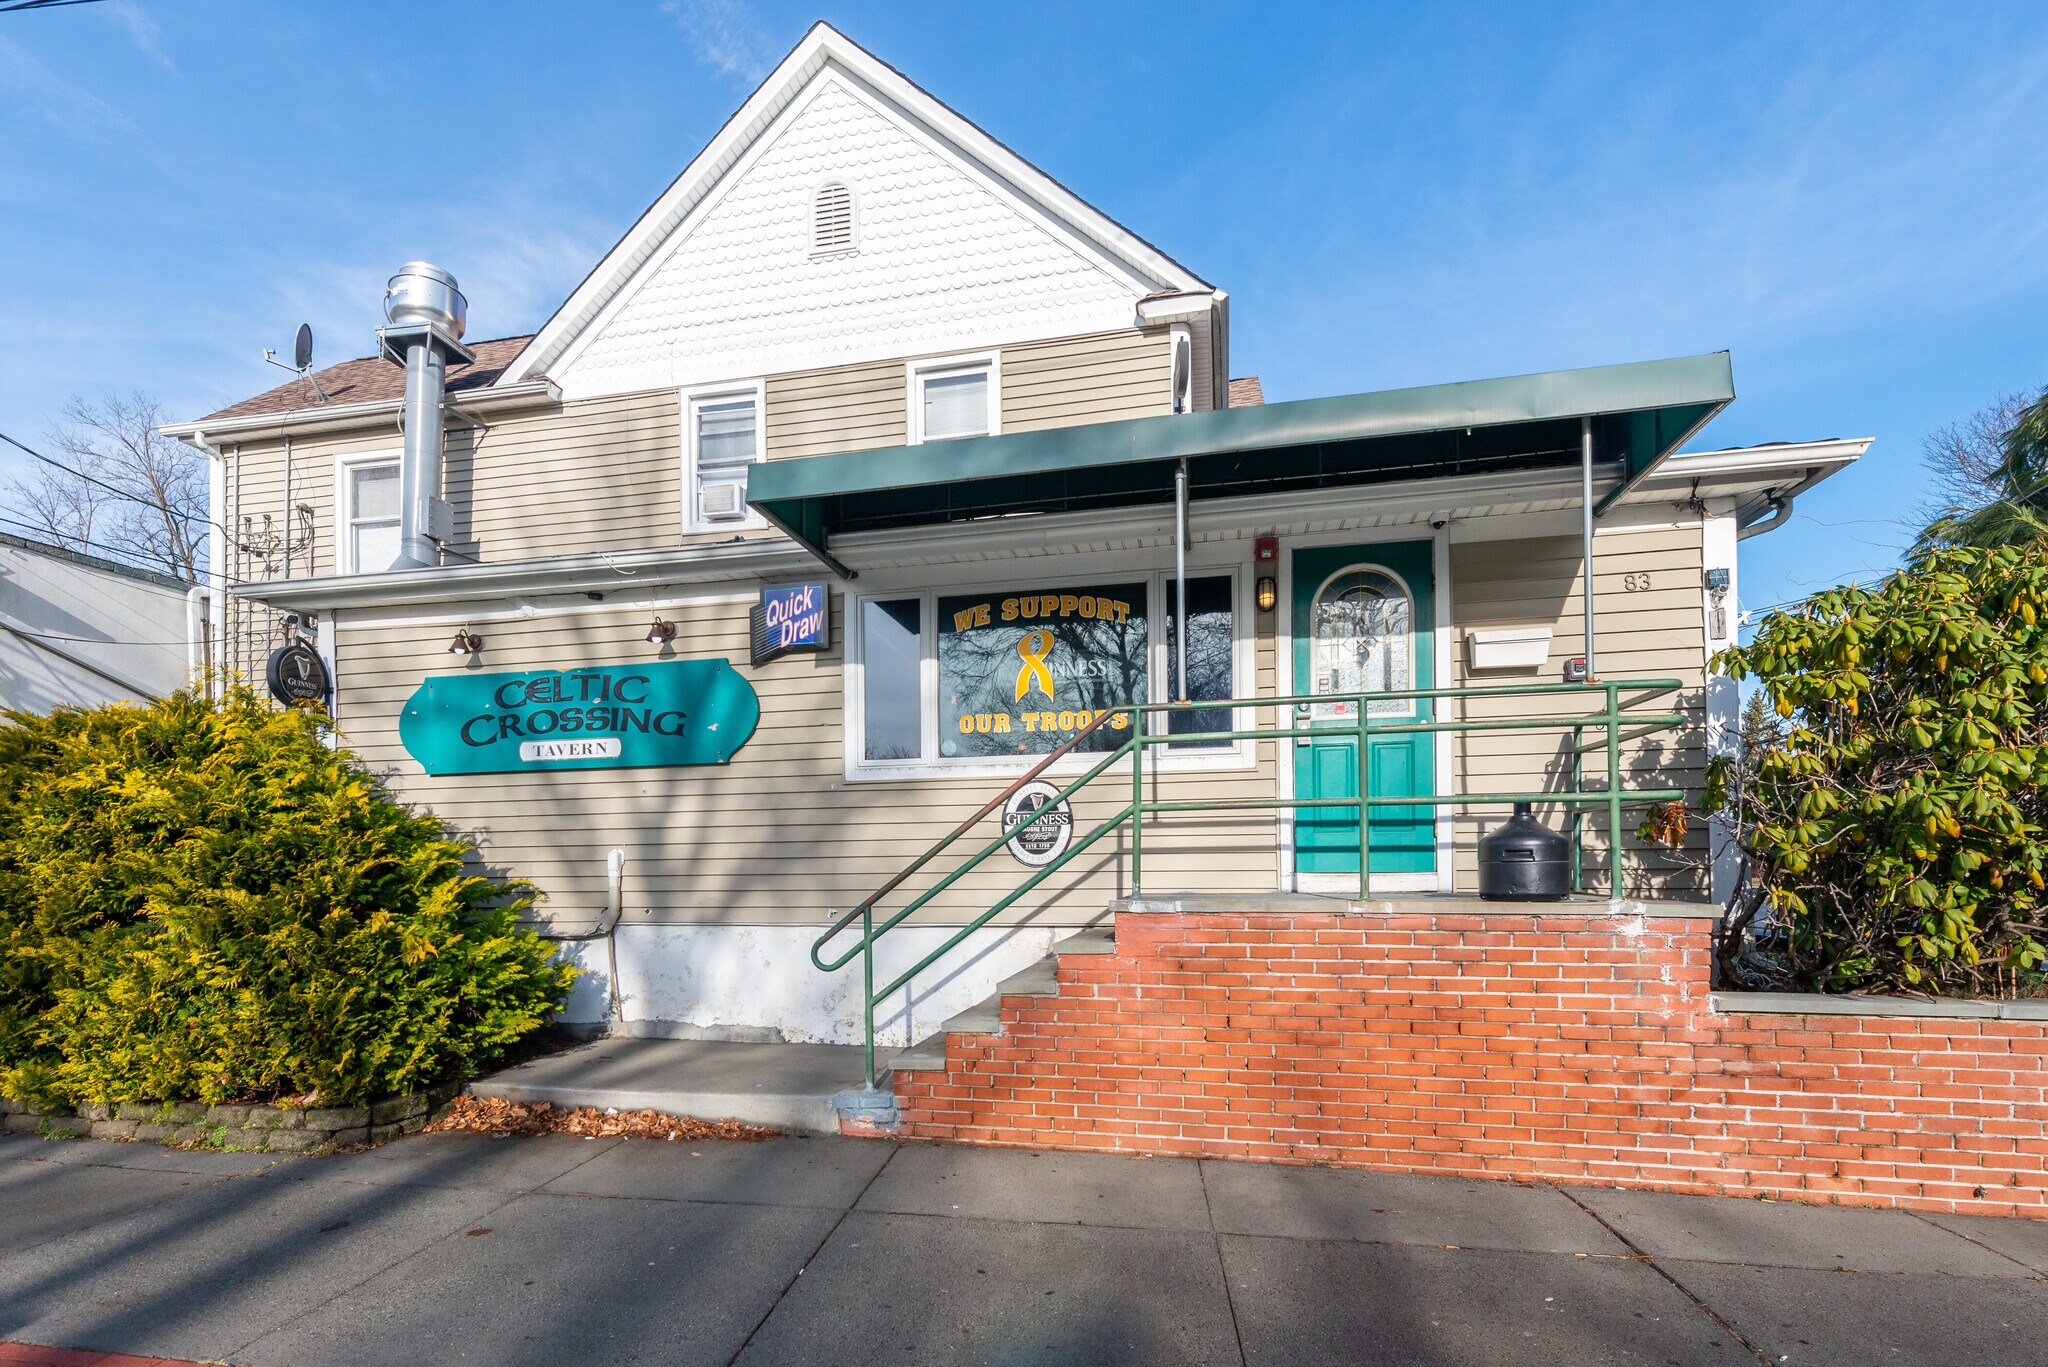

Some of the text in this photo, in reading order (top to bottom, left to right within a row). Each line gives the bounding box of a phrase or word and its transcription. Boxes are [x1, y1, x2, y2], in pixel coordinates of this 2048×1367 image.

[1624, 573, 1651, 591] 83
[766, 585, 814, 627] Quick
[953, 595, 1130, 633] WE SUPPORT
[781, 610, 823, 648] Draw
[1046, 660, 1107, 677] INNESS
[287, 677, 318, 690] GUINNESS
[494, 674, 651, 709] CELTIC
[460, 707, 688, 747] CROSSING
[959, 713, 1011, 734] OUR
[533, 741, 608, 757] TAVERN
